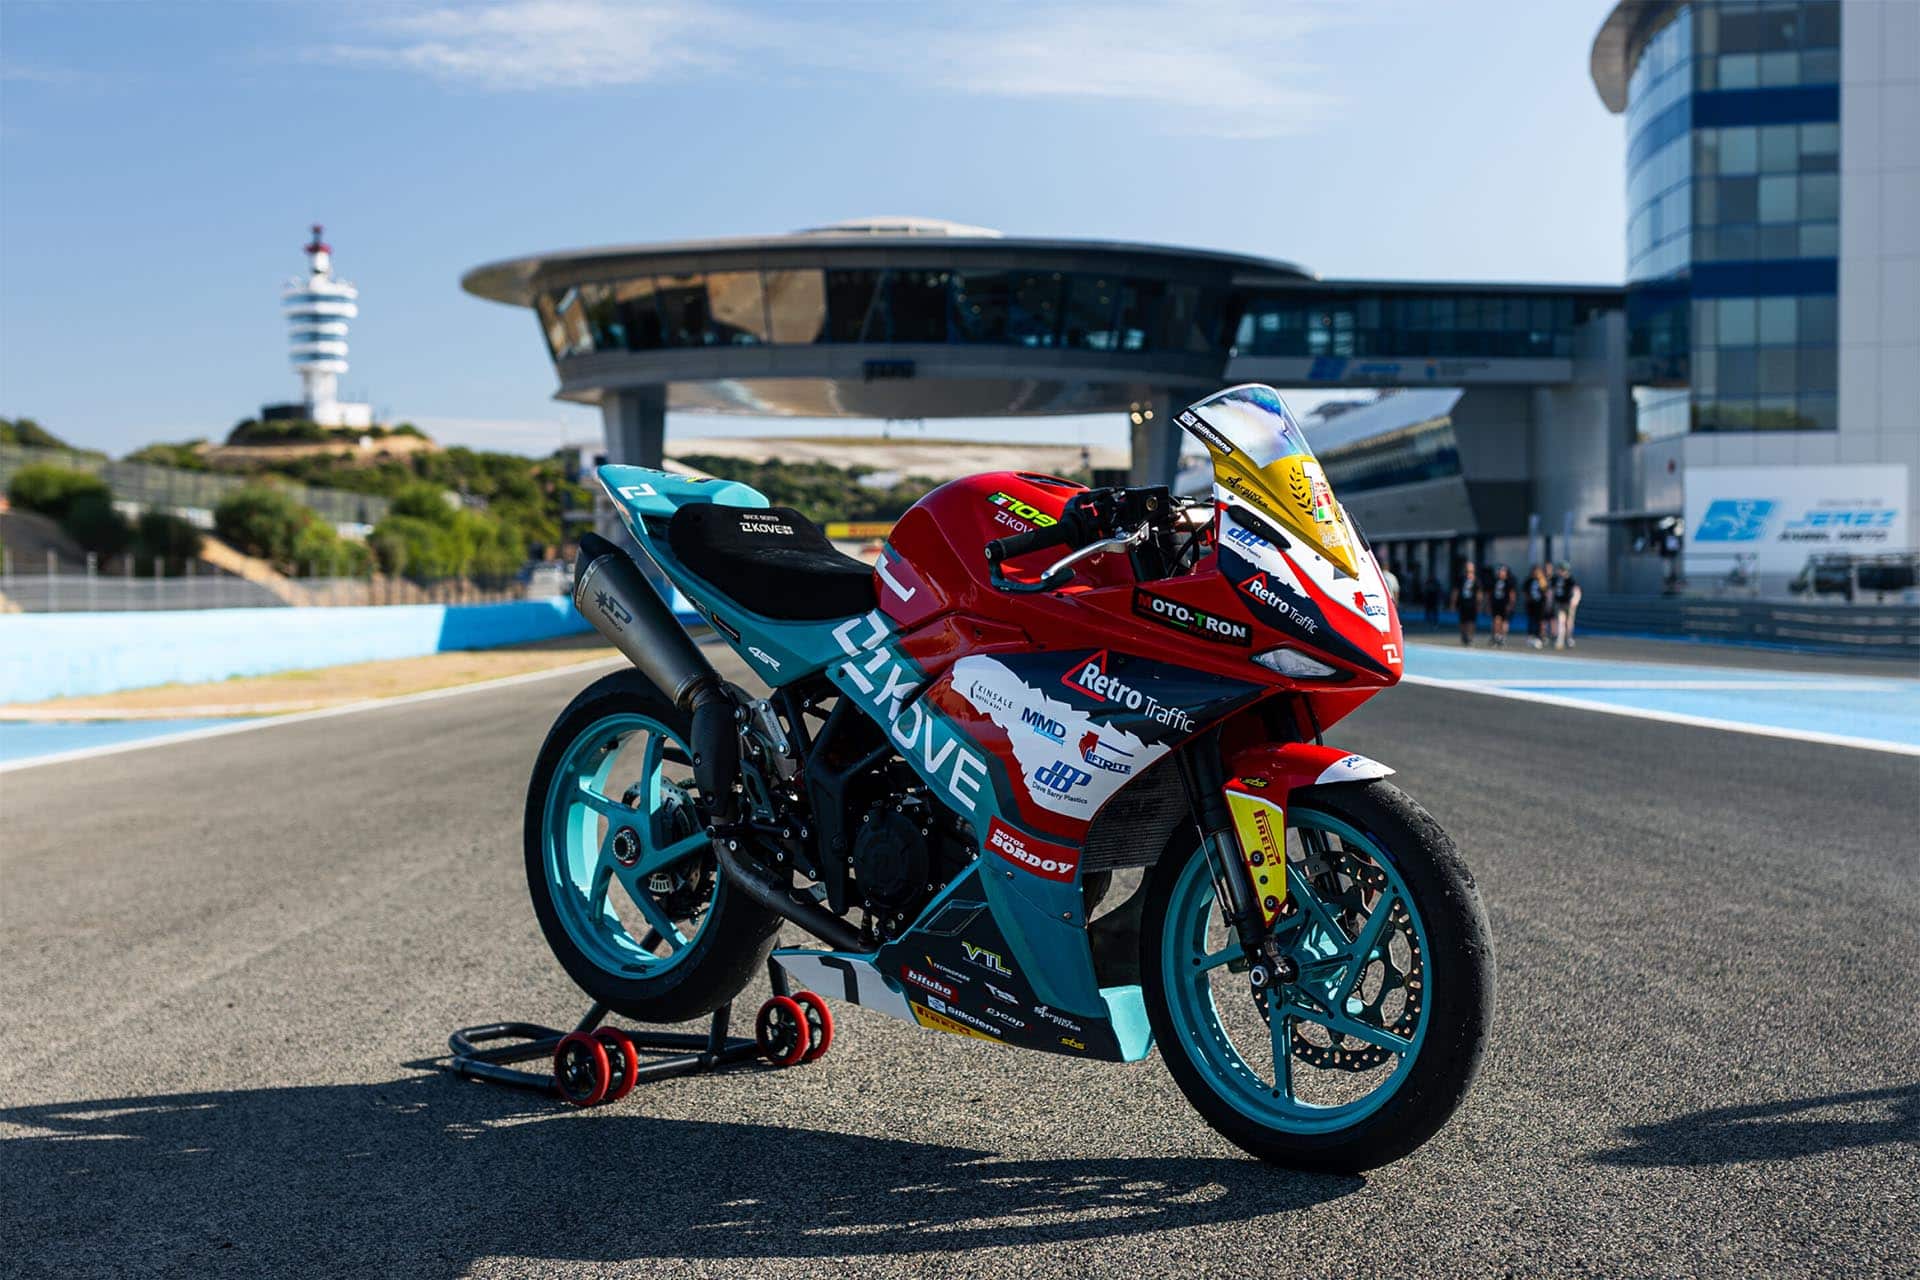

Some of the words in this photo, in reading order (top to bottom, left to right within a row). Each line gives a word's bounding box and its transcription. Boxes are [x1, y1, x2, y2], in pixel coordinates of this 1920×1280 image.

[1138, 593, 1247, 638] MOTO-TRON
[1249, 580, 1289, 613] Retro
[1289, 606, 1318, 634] Traffic
[978, 685, 1013, 709] KINSALE
[1078, 662, 1142, 710] Retro
[1144, 695, 1195, 733] Traffic
[1021, 706, 1066, 738] MMD
[1032, 781, 1046, 794] Dave
[991, 834, 1074, 874] BORDOY
[995, 828, 1025, 849] MOTOS
[1253, 809, 1281, 867] PIRELLI
[947, 1006, 1002, 1035] Silkolene
